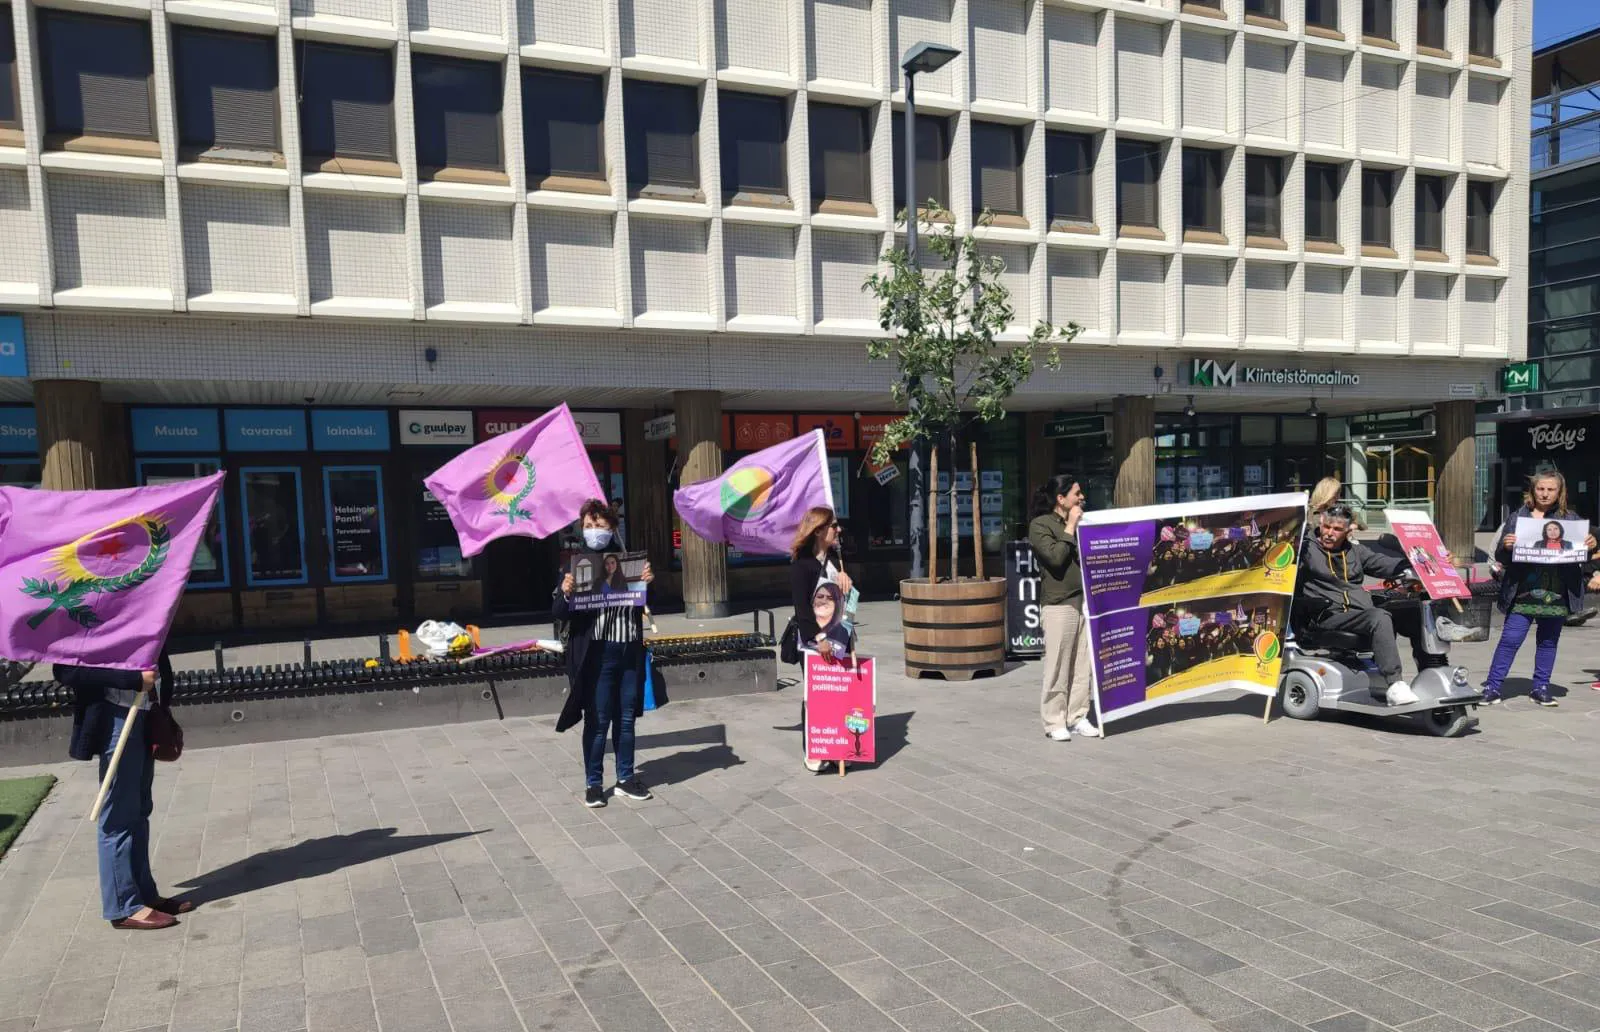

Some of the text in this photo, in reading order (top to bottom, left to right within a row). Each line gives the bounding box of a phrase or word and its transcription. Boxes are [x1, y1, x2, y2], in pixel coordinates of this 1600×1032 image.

[1194, 358, 1360, 387] KM Kiinteistömaailma
[154, 425, 198, 436] Muuta
[240, 426, 292, 437] tavarasi
[326, 426, 376, 436] lainaksi.
[423, 422, 467, 435] guulpay
[1528, 423, 1586, 450] Todays
[334, 506, 376, 515] Helsingin
[335, 515, 362, 523] Pantti
